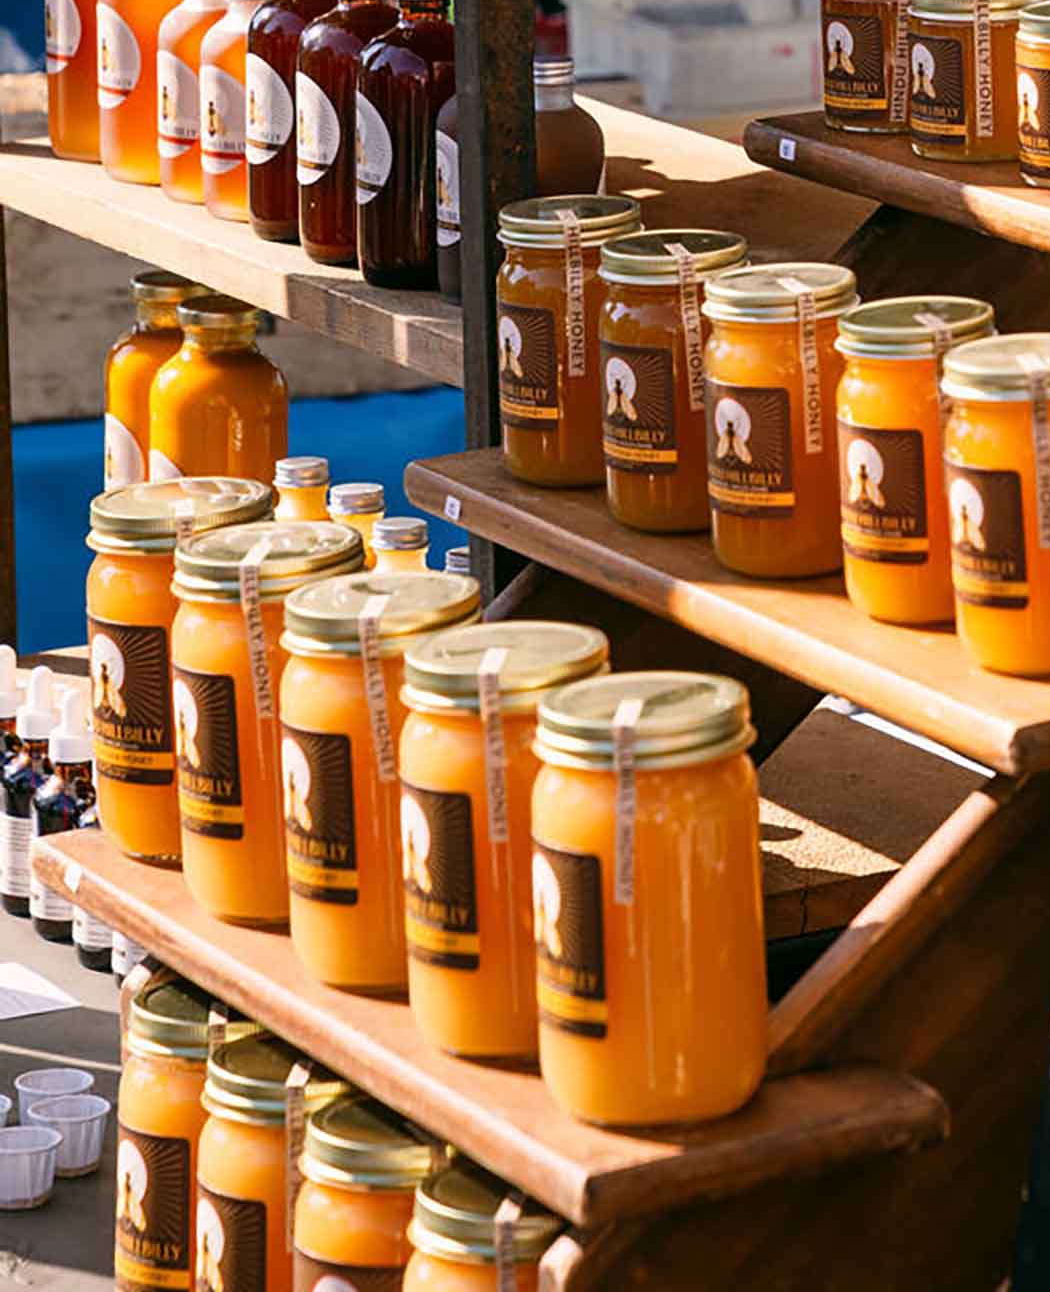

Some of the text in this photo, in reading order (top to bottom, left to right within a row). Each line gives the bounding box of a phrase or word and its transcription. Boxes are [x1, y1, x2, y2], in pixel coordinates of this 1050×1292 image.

[892, 66, 907, 121] HINDU
[979, 74, 991, 132] HONEY
[567, 226, 584, 370] HILLBILLY HONEY
[689, 342, 705, 405] HONEY
[800, 292, 821, 447] HILLBILLY HONEY
[255, 650, 272, 717] HONEY
[376, 709, 395, 777] HONEY
